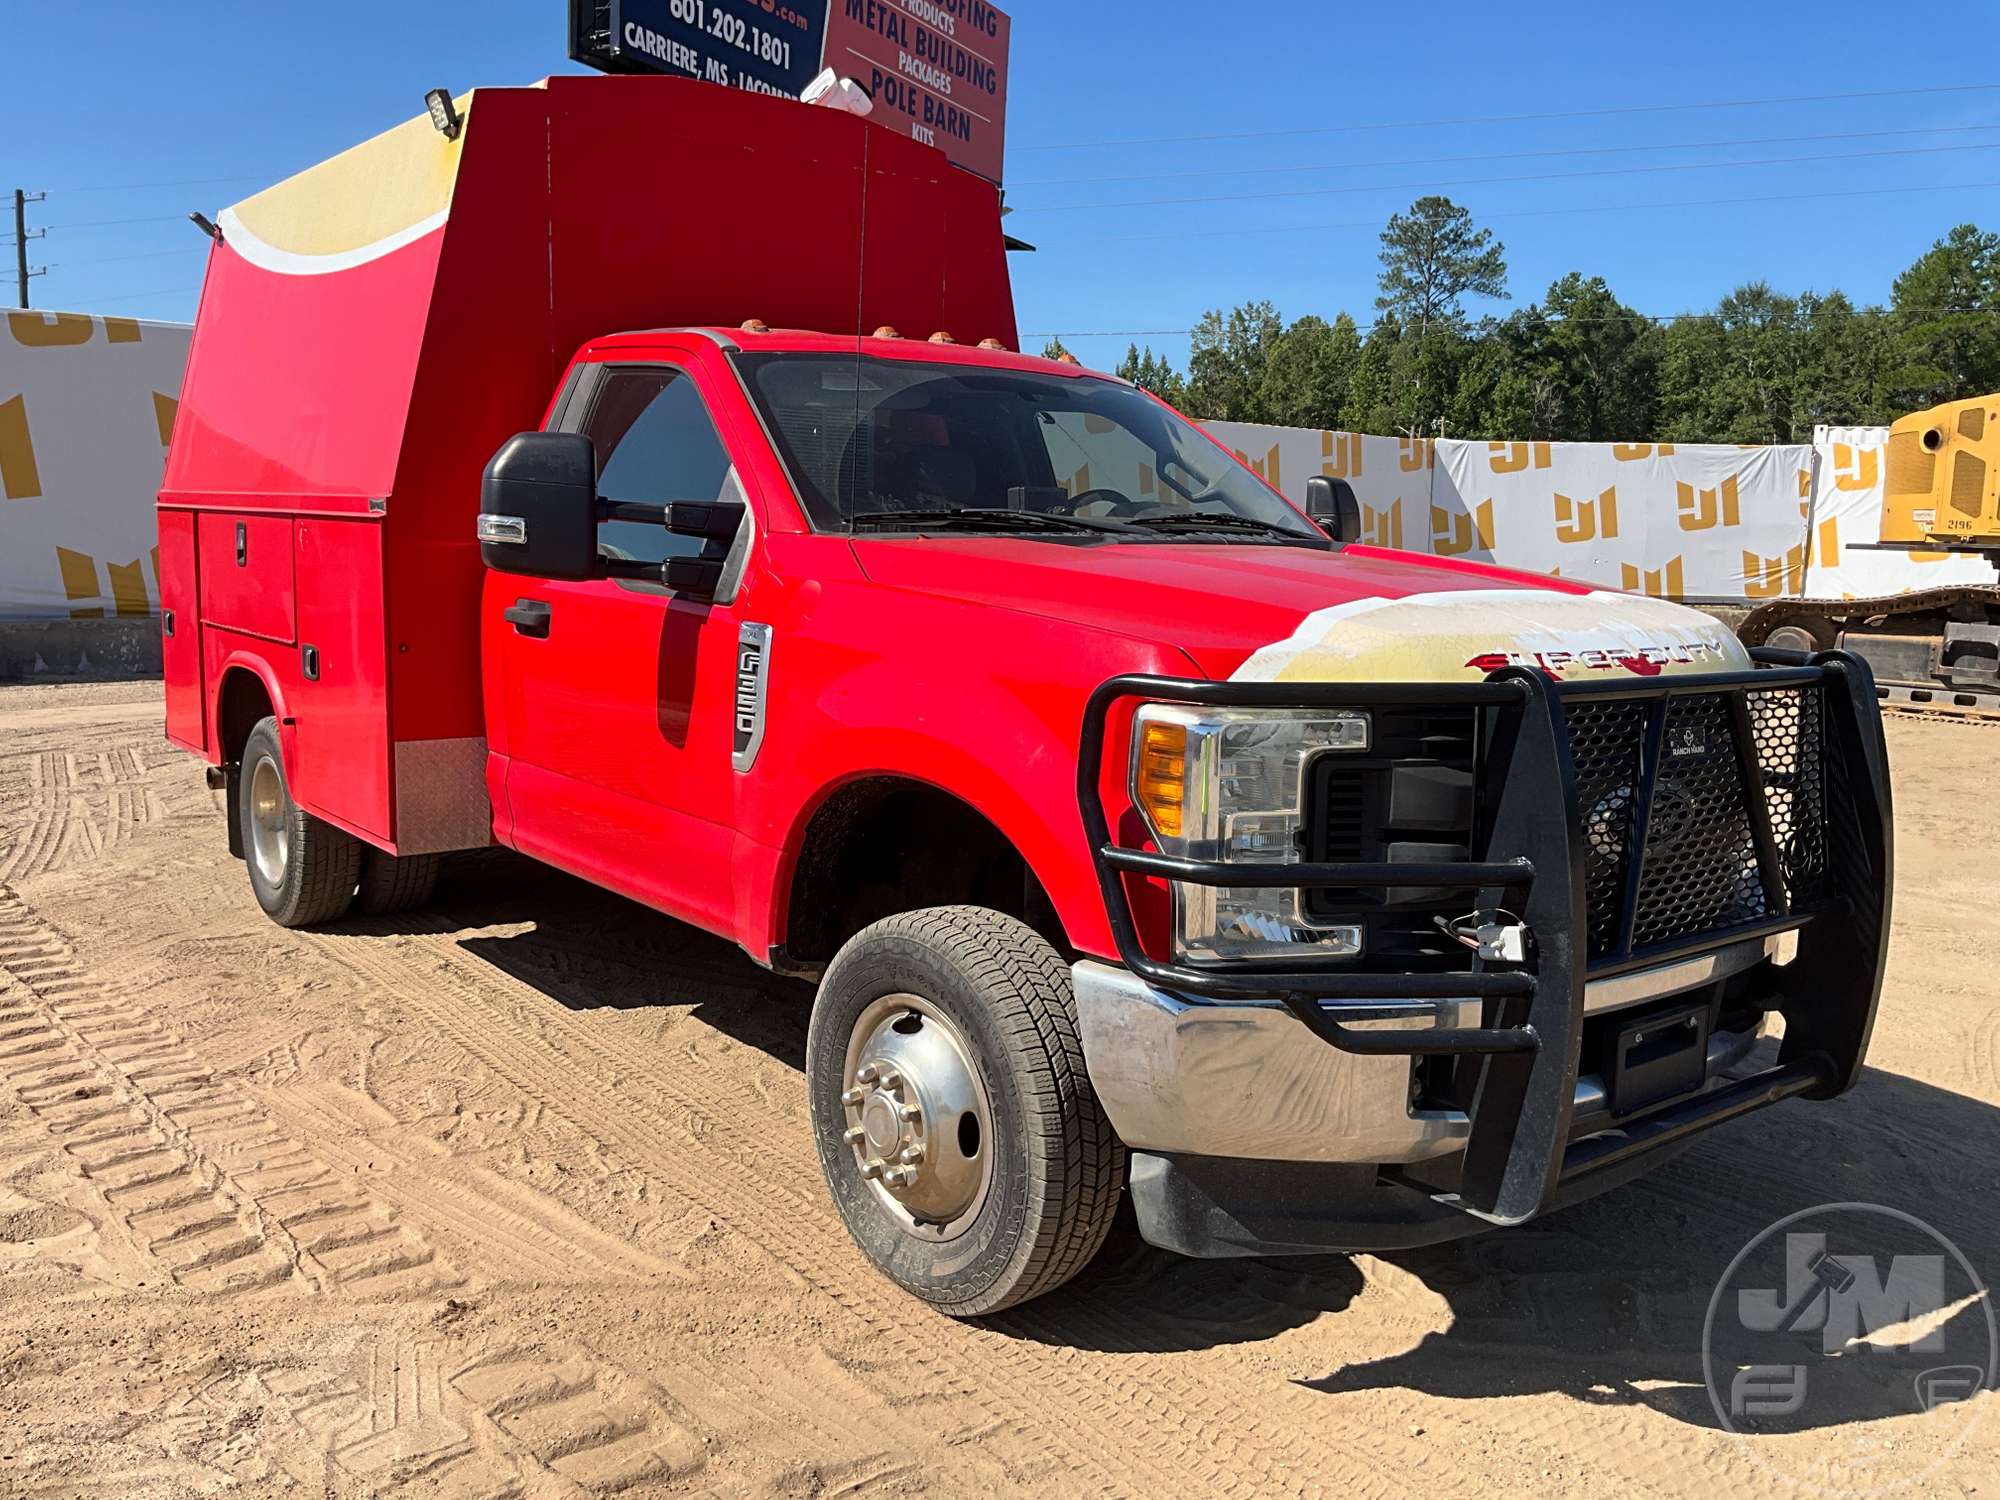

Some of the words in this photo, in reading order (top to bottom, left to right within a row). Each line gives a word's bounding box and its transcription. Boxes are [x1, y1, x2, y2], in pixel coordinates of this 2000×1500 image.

[624, 21, 702, 80] CARRIERE,
[705, 56, 728, 87] MS
[669, 0, 790, 70] 601.202.1801
[845, 0, 908, 49] METAL
[915, 26, 997, 96] BUILDING
[872, 67, 917, 118] POLE
[923, 94, 971, 143] BARN
[899, 50, 952, 95] PACKAGES
[911, 122, 935, 148] KITS
[1948, 519, 1972, 530] 2196
